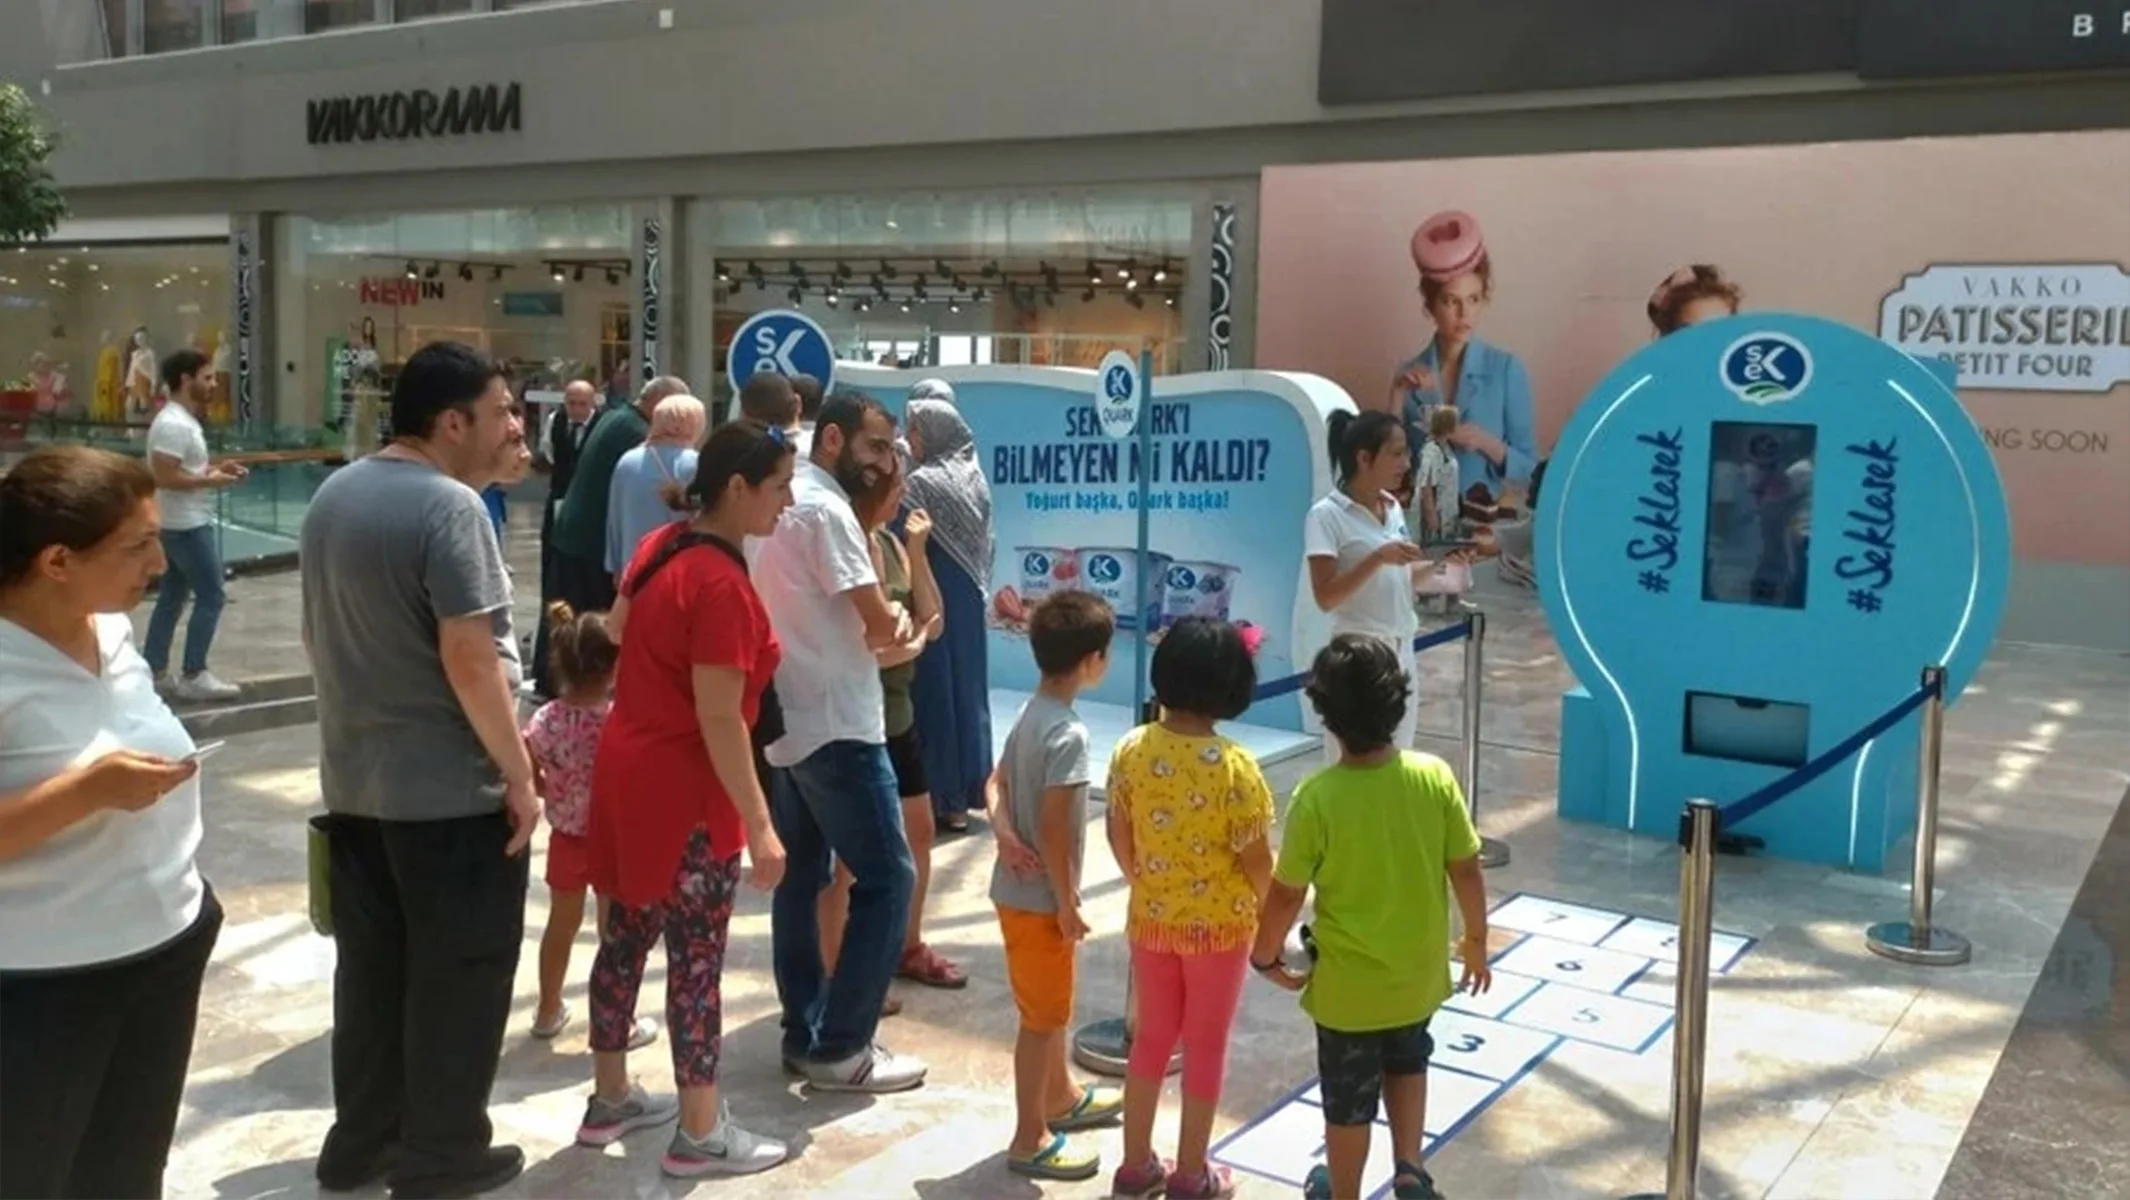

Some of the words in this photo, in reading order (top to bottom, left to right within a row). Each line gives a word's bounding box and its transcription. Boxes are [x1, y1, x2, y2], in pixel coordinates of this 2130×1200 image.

[307, 81, 521, 145] VAKKORAMA
[360, 277, 420, 306] NEW
[422, 281, 444, 299] IN
[1963, 275, 2081, 298] VAKKO
[2017, 353, 2093, 377] FOUR
[2029, 429, 2109, 454] SOON
[1171, 438, 1272, 483] KALDI?
[1571, 1006, 1600, 1025] 5
[1446, 1033, 1486, 1053] 3
